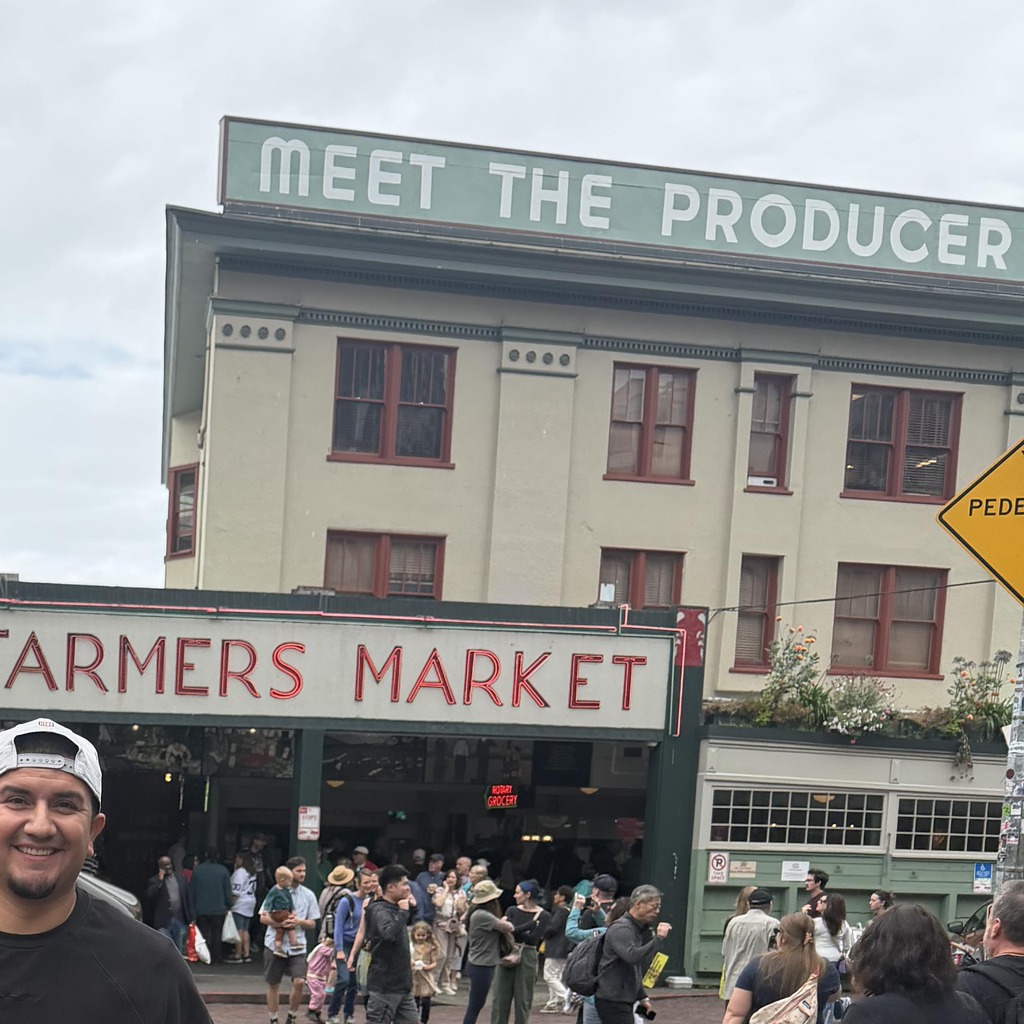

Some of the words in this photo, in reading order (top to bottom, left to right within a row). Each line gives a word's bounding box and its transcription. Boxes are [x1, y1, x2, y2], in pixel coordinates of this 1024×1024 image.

[260, 137, 446, 209] MEET
[489, 162, 613, 229] THE
[661, 183, 1012, 270] PRODUCER
[355, 644, 648, 710] MARKET
[487, 795, 518, 806] GROCERY
